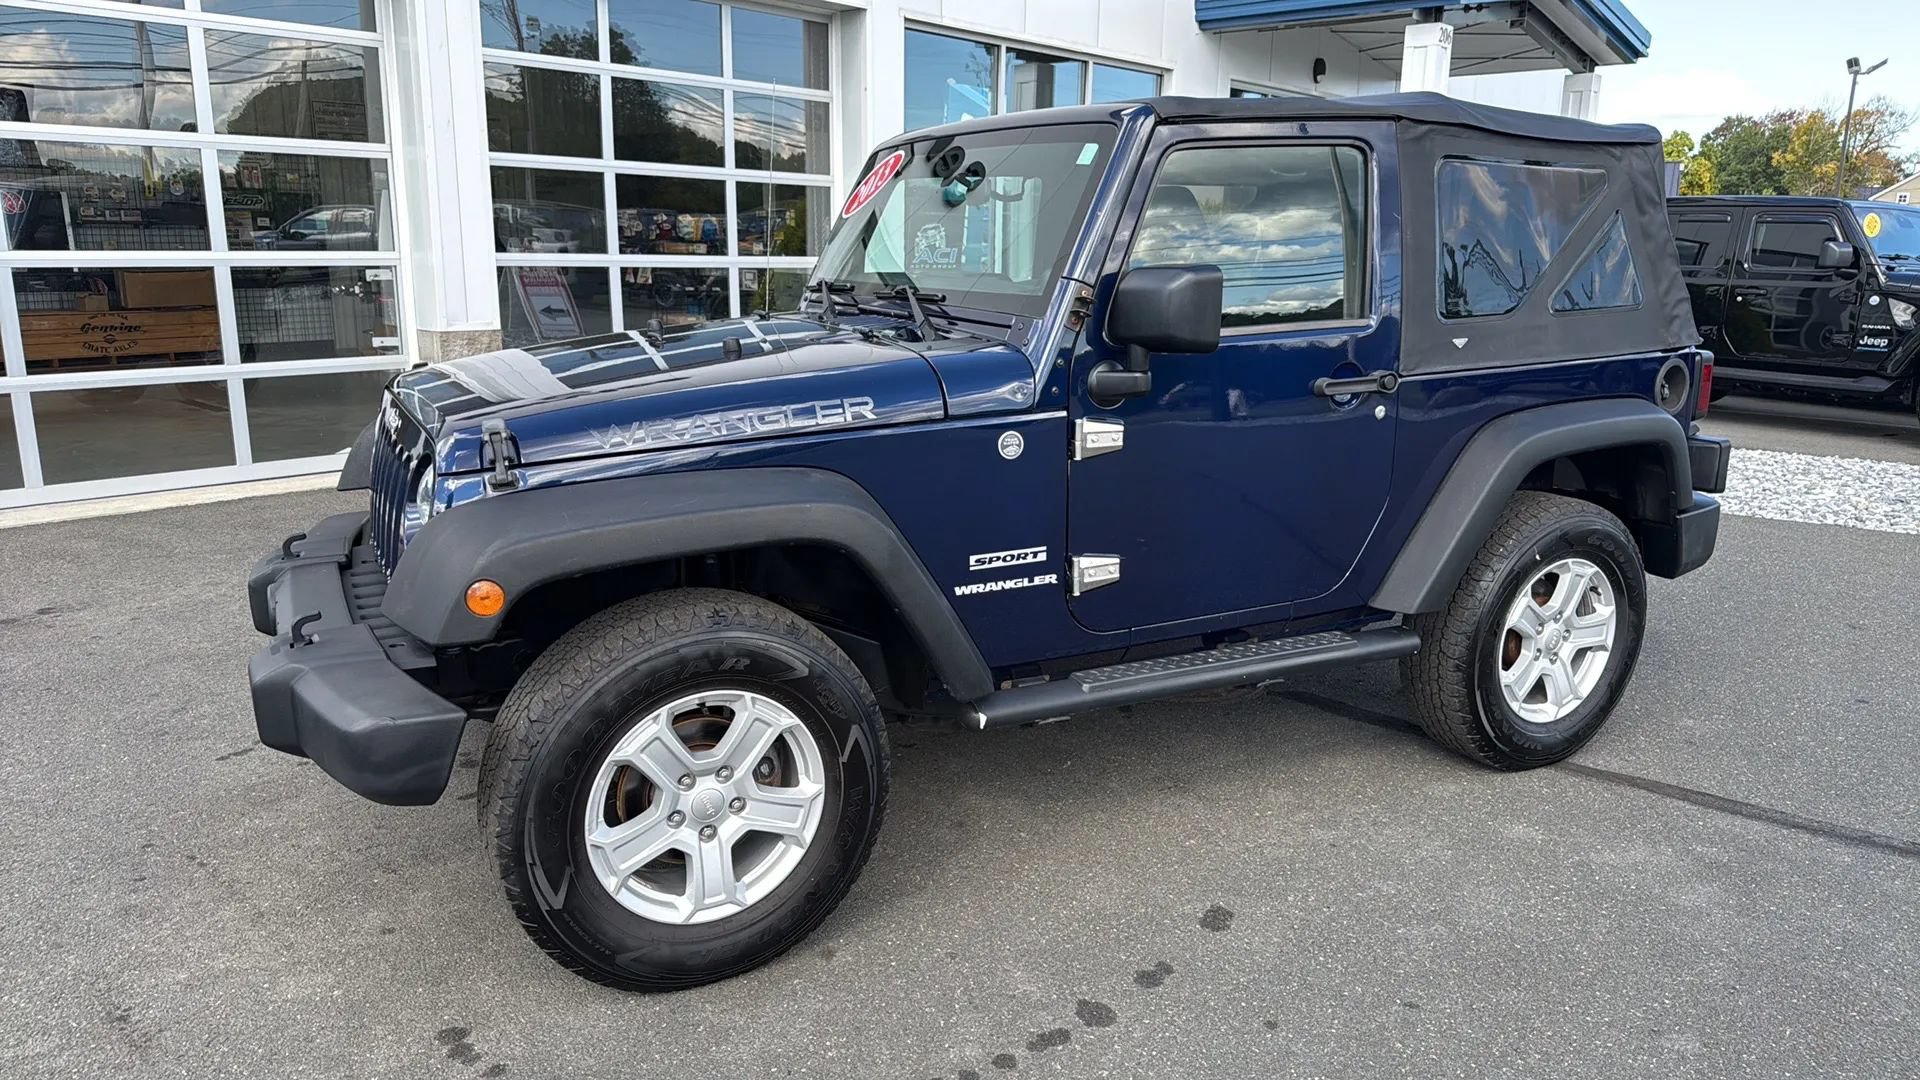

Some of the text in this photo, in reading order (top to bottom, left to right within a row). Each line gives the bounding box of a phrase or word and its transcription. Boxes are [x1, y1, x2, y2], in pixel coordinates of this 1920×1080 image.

[1438, 26, 1452, 45] 206
[848, 157, 896, 212] 2013
[912, 247, 958, 263] ACI
[1859, 335, 1889, 347] Jeep
[585, 396, 878, 449] WRANGLER
[972, 550, 1042, 567] SPORT
[953, 573, 1058, 596] WRANGLER
